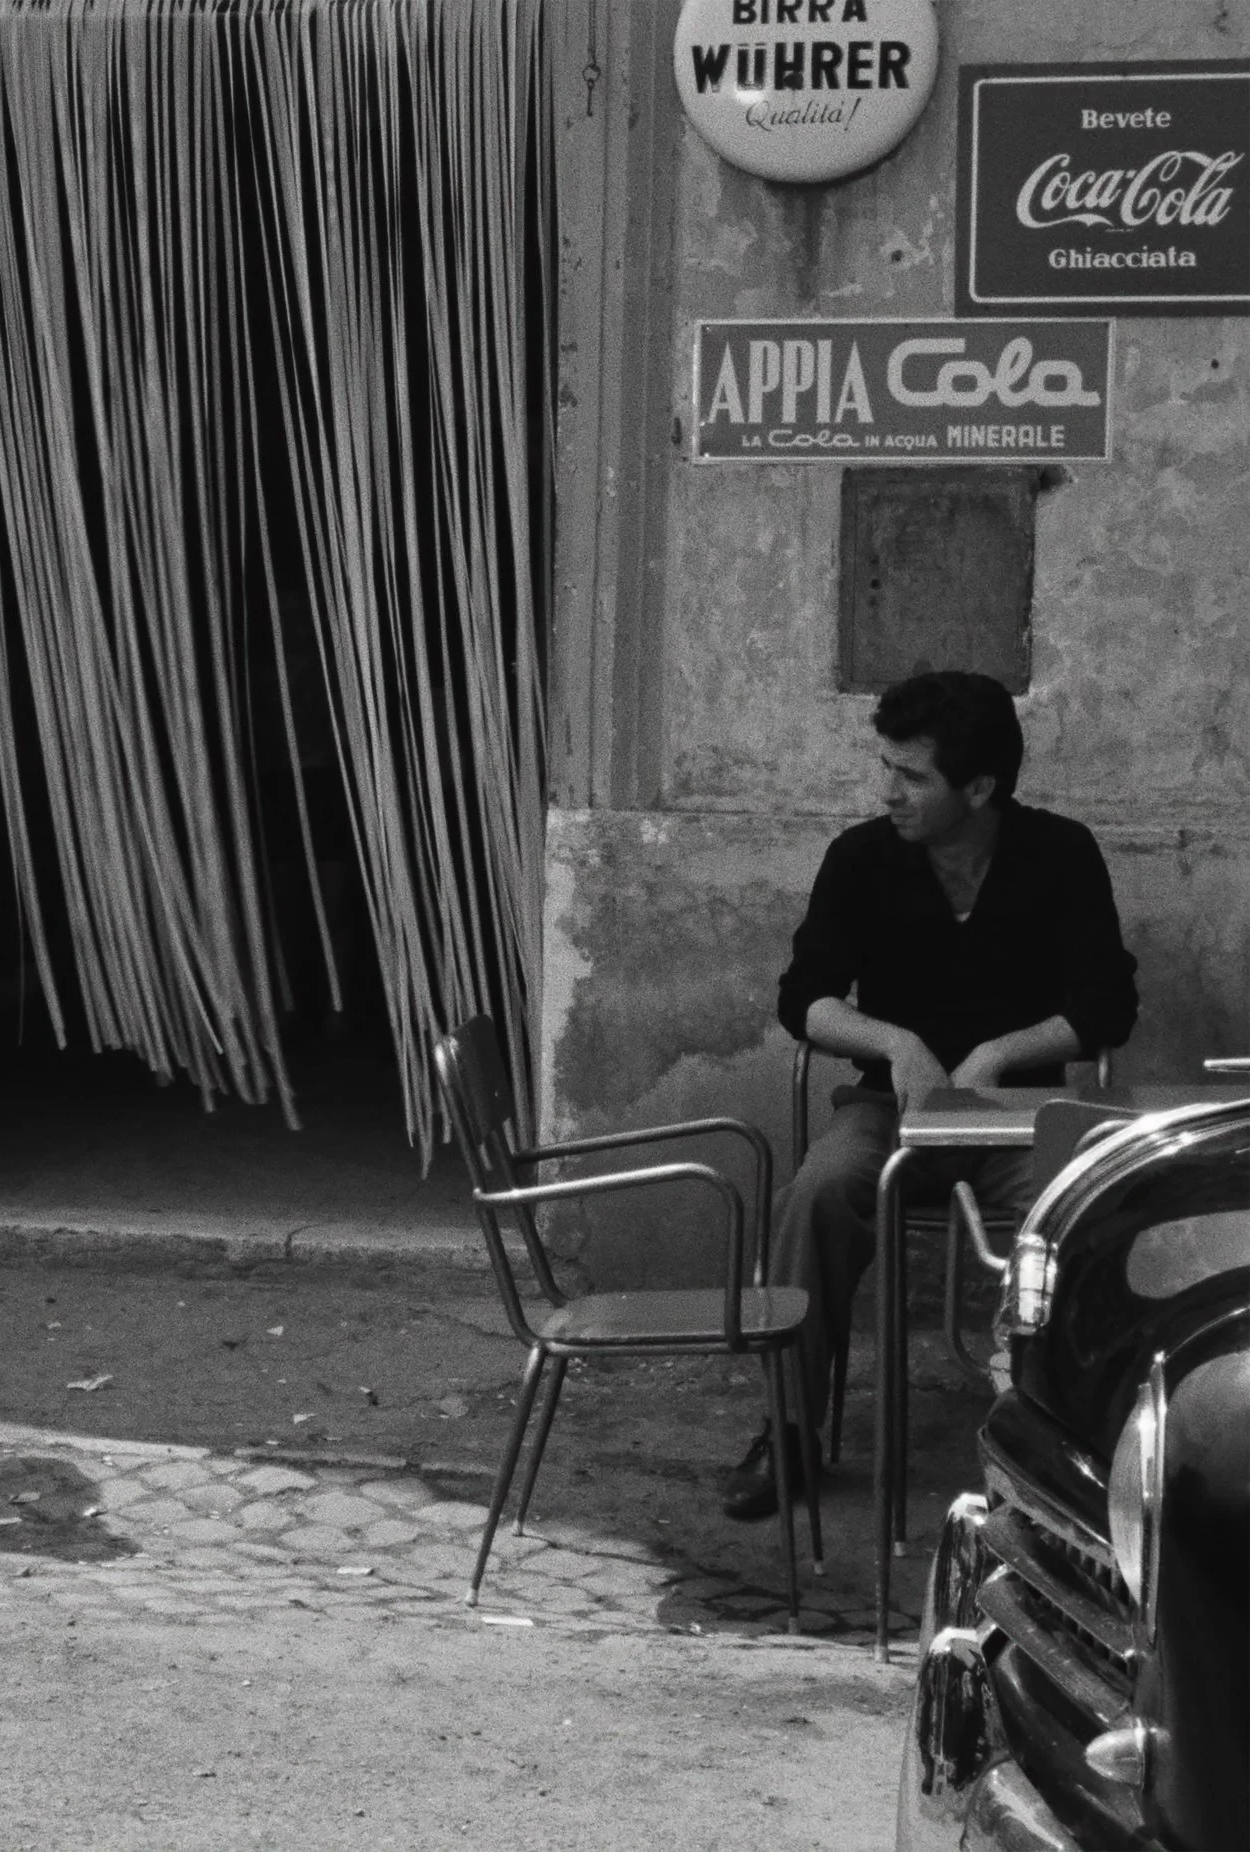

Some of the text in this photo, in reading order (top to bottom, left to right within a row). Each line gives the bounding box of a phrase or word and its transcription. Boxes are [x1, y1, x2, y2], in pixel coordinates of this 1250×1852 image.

[733, 0, 868, 25] BIRRA
[691, 41, 911, 94] WÜHRER
[1080, 107, 1172, 130] Bevete
[1015, 150, 1246, 229] Coca-Cola
[1049, 246, 1197, 269] Ghiacciata
[706, 336, 1103, 424] APPIA Cola
[741, 425, 1067, 451] LA Cola IN ACQUA MINERALE
